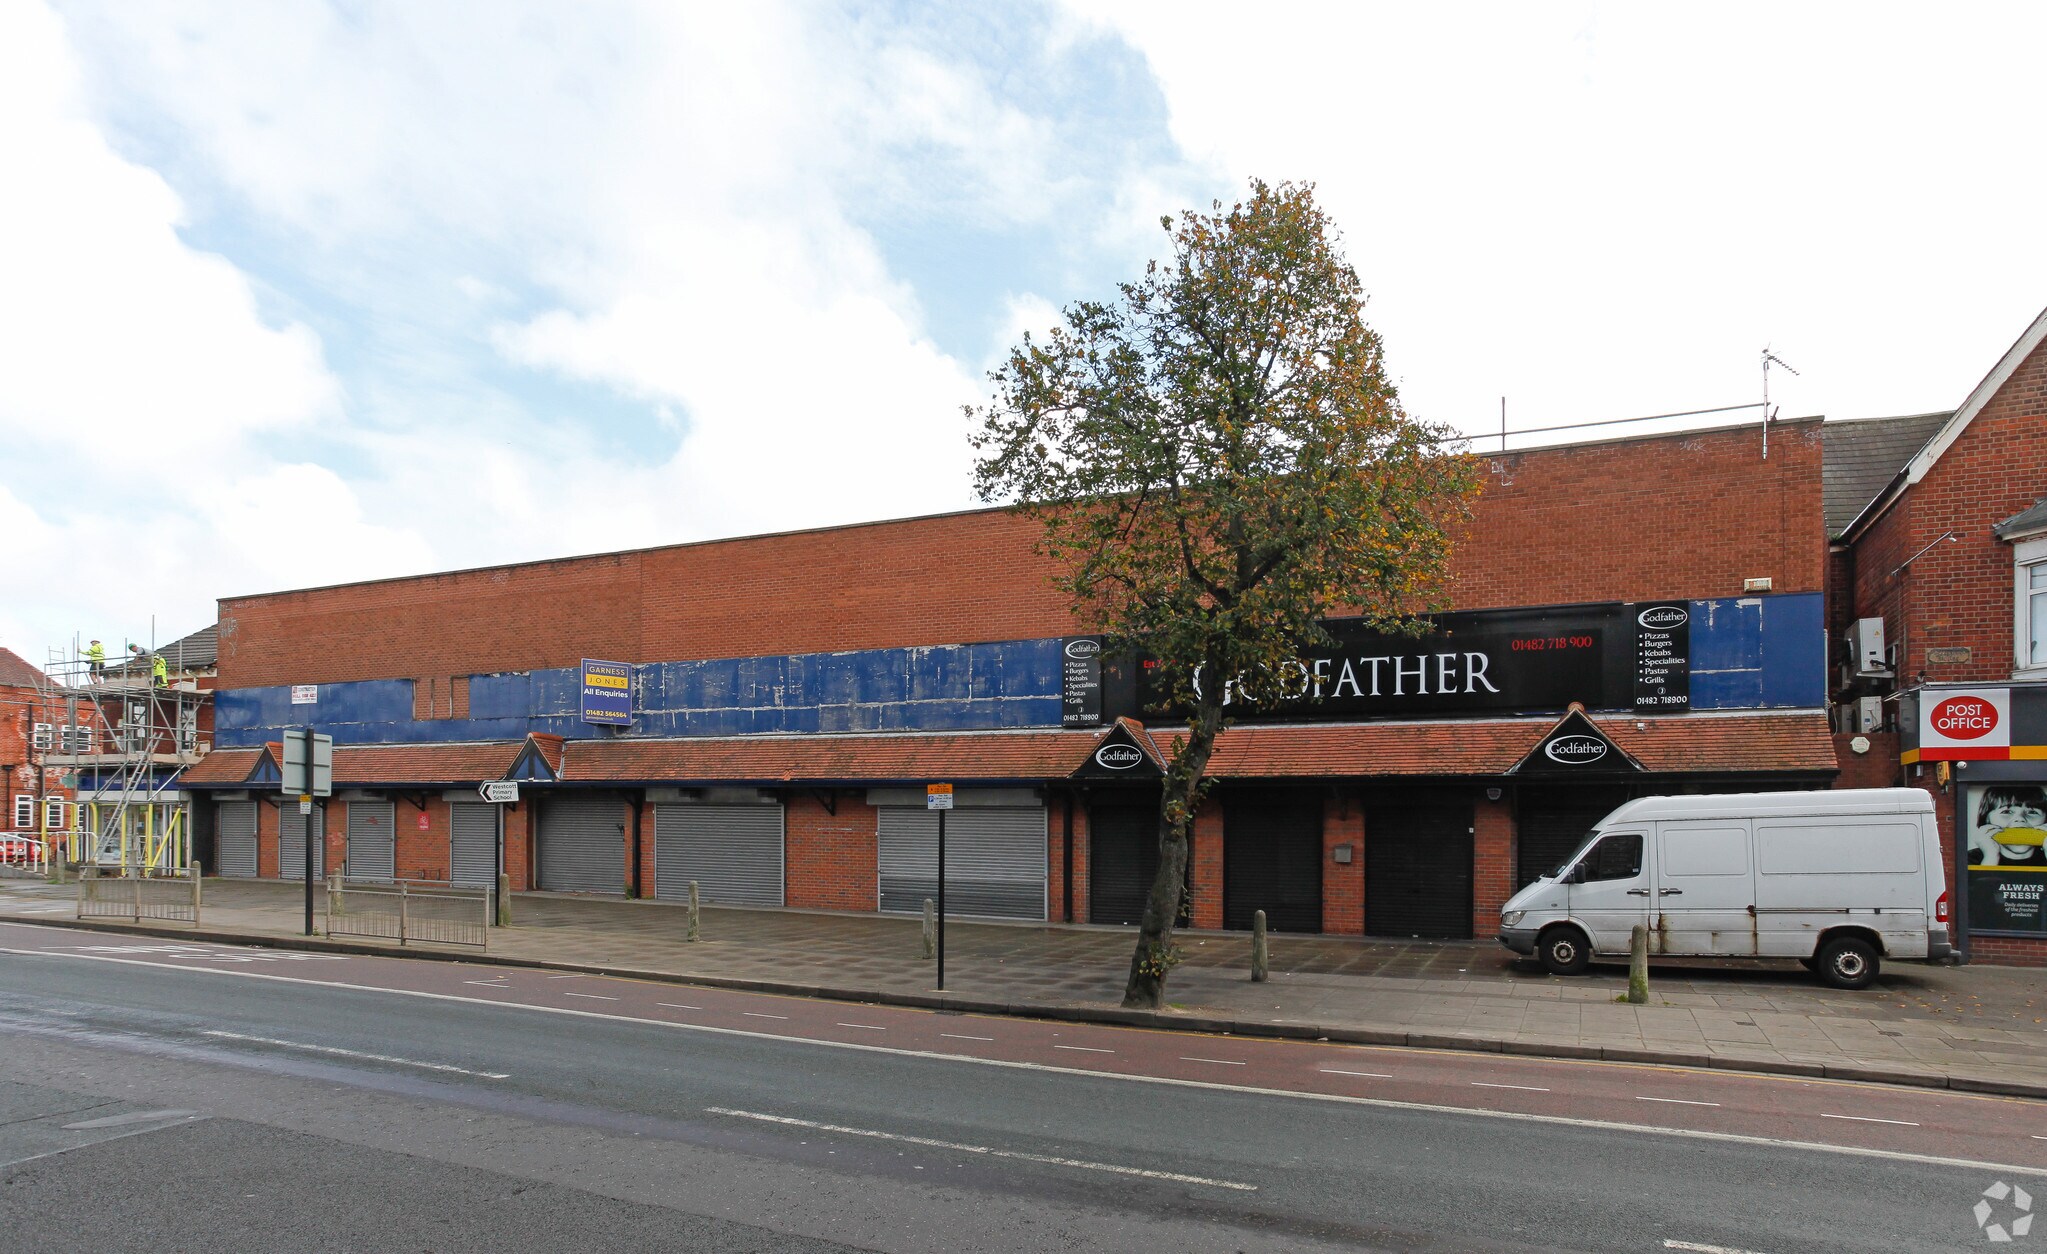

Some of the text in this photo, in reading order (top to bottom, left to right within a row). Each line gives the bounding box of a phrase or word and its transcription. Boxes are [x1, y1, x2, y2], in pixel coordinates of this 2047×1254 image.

[1642, 611, 1685, 623] Godfather
[1511, 635, 1593, 651] 01482 718 900
[1644, 640, 1673, 649] Burgers
[1644, 648, 1672, 657] Kebabs
[1644, 656, 1686, 667] Specialities
[589, 666, 625, 675] GARNESS
[1069, 668, 1089, 676] Burgers
[1644, 667, 1669, 675] Pastas
[589, 677, 625, 686] JONES
[1644, 676, 1665, 684] Grills
[1069, 682, 1098, 690] Specialities
[595, 689, 628, 697] Enquiries
[1636, 695, 1688, 705] 01482 718900
[1946, 704, 1983, 717] POST
[1063, 713, 1099, 722] 01482 718900
[1937, 717, 1991, 730] OFFICE
[1550, 742, 1604, 755] Godfather
[1100, 750, 1140, 761] Godfather
[1999, 884, 2044, 892] ALWAYS
[2003, 892, 2040, 900] FRESH
